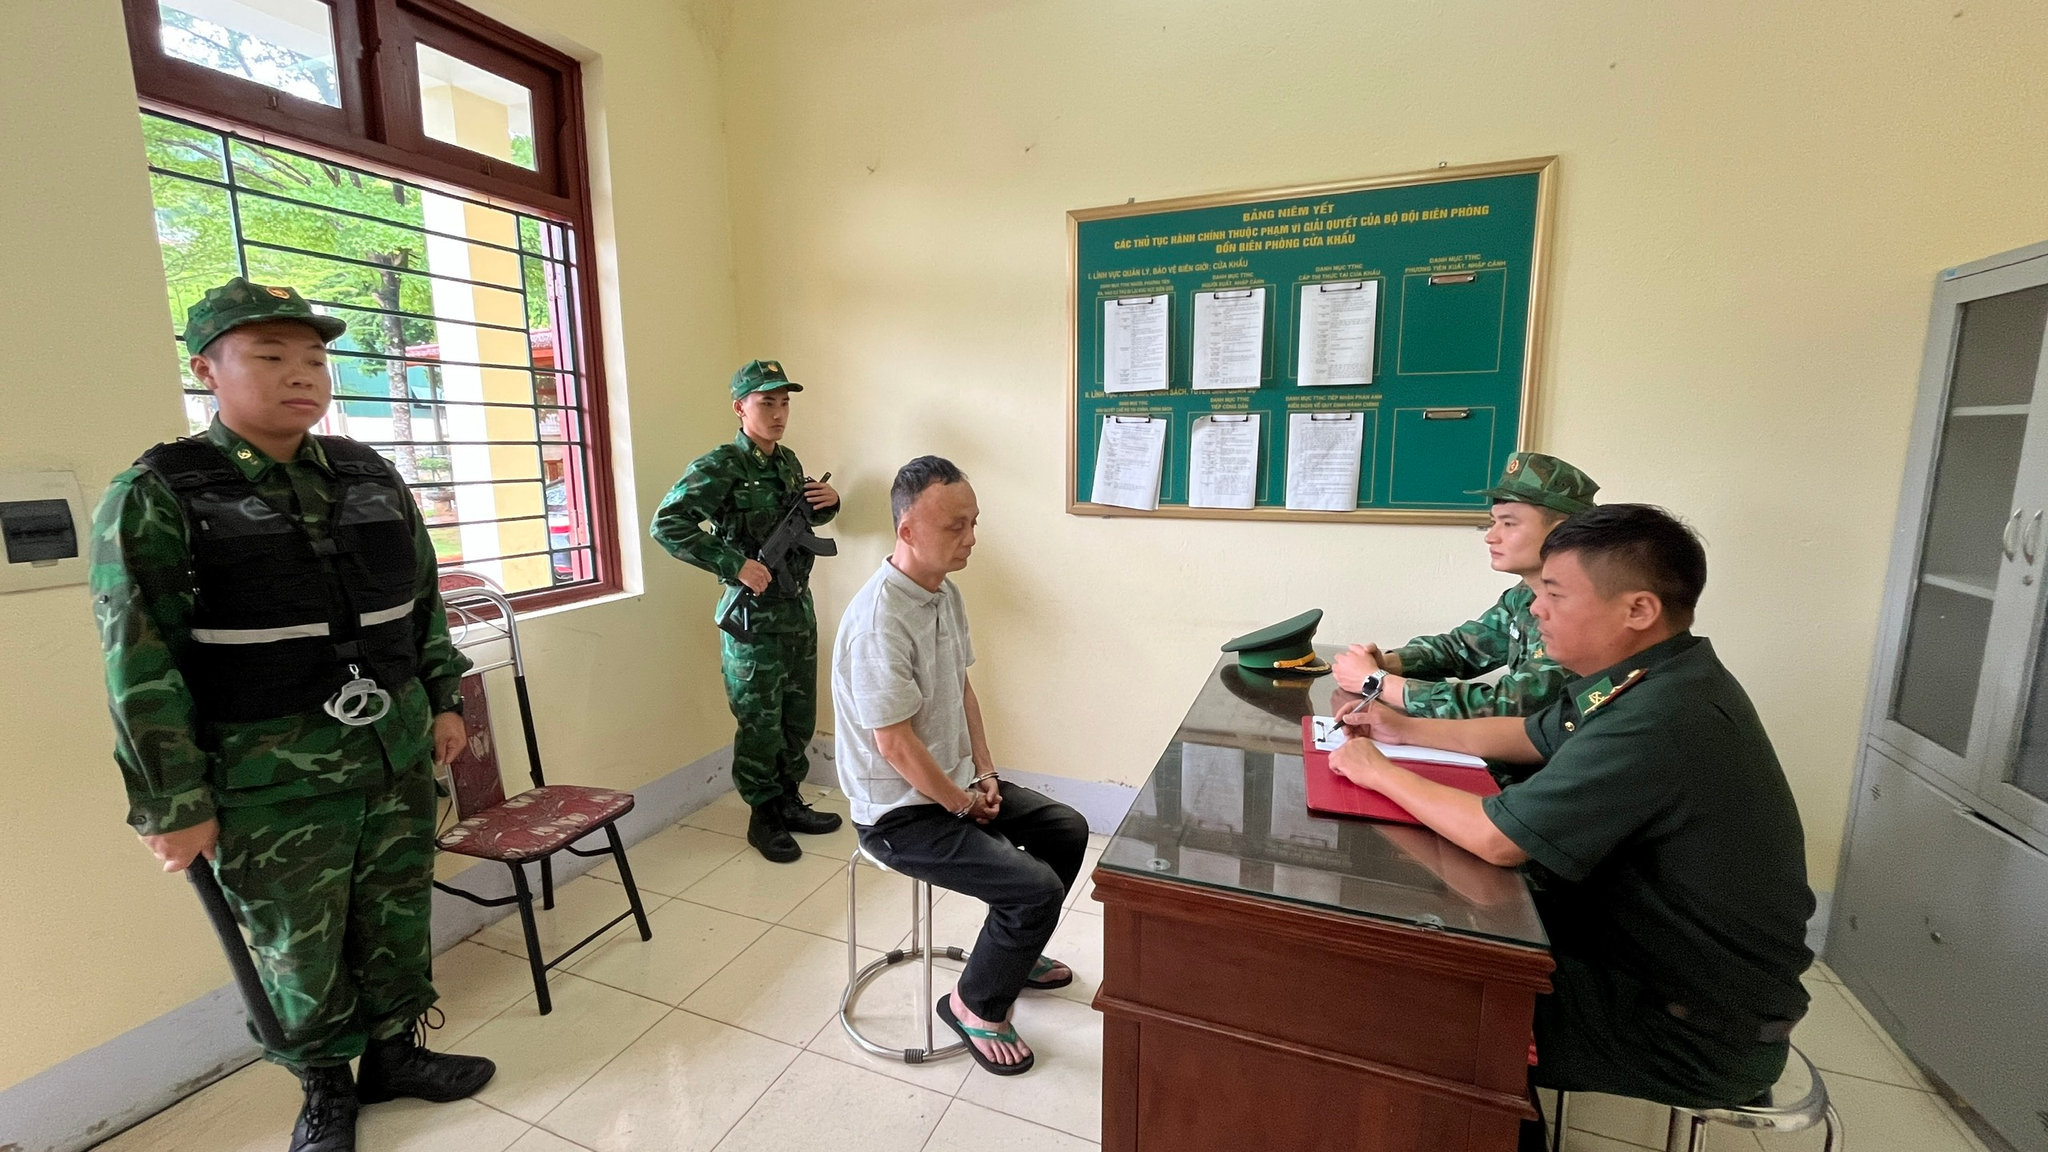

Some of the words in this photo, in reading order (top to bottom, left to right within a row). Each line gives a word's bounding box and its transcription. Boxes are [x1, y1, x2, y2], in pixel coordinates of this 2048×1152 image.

[1243, 208, 1274, 222] BẢNG
[1278, 204, 1309, 217] NIÊM
[1313, 201, 1335, 214] YẾT
[1114, 239, 1131, 250] CÁC
[1134, 235, 1150, 248] THỦ
[1152, 237, 1169, 248] TỤC
[1171, 234, 1196, 244] HÀNH
[1198, 229, 1226, 242] CHÍNH
[1228, 227, 1258, 239] THUỘC
[1261, 224, 1289, 236] PHẠM
[1291, 223, 1301, 233] VI
[1304, 219, 1323, 232] GIẢI
[1326, 215, 1358, 230] QUYẾT
[1361, 213, 1381, 226] CỦA
[1384, 211, 1398, 226] BỘ
[1401, 209, 1419, 223] ĐỘI
[1422, 207, 1448, 220] BIÊN
[1451, 204, 1489, 217] PHÒNG
[1216, 241, 1237, 254] ĐỒN
[1239, 240, 1262, 252] BIÊN
[1265, 237, 1299, 249] PHÒNG
[1303, 233, 1324, 247] CỬA
[1327, 228, 1356, 246] KHẨU
